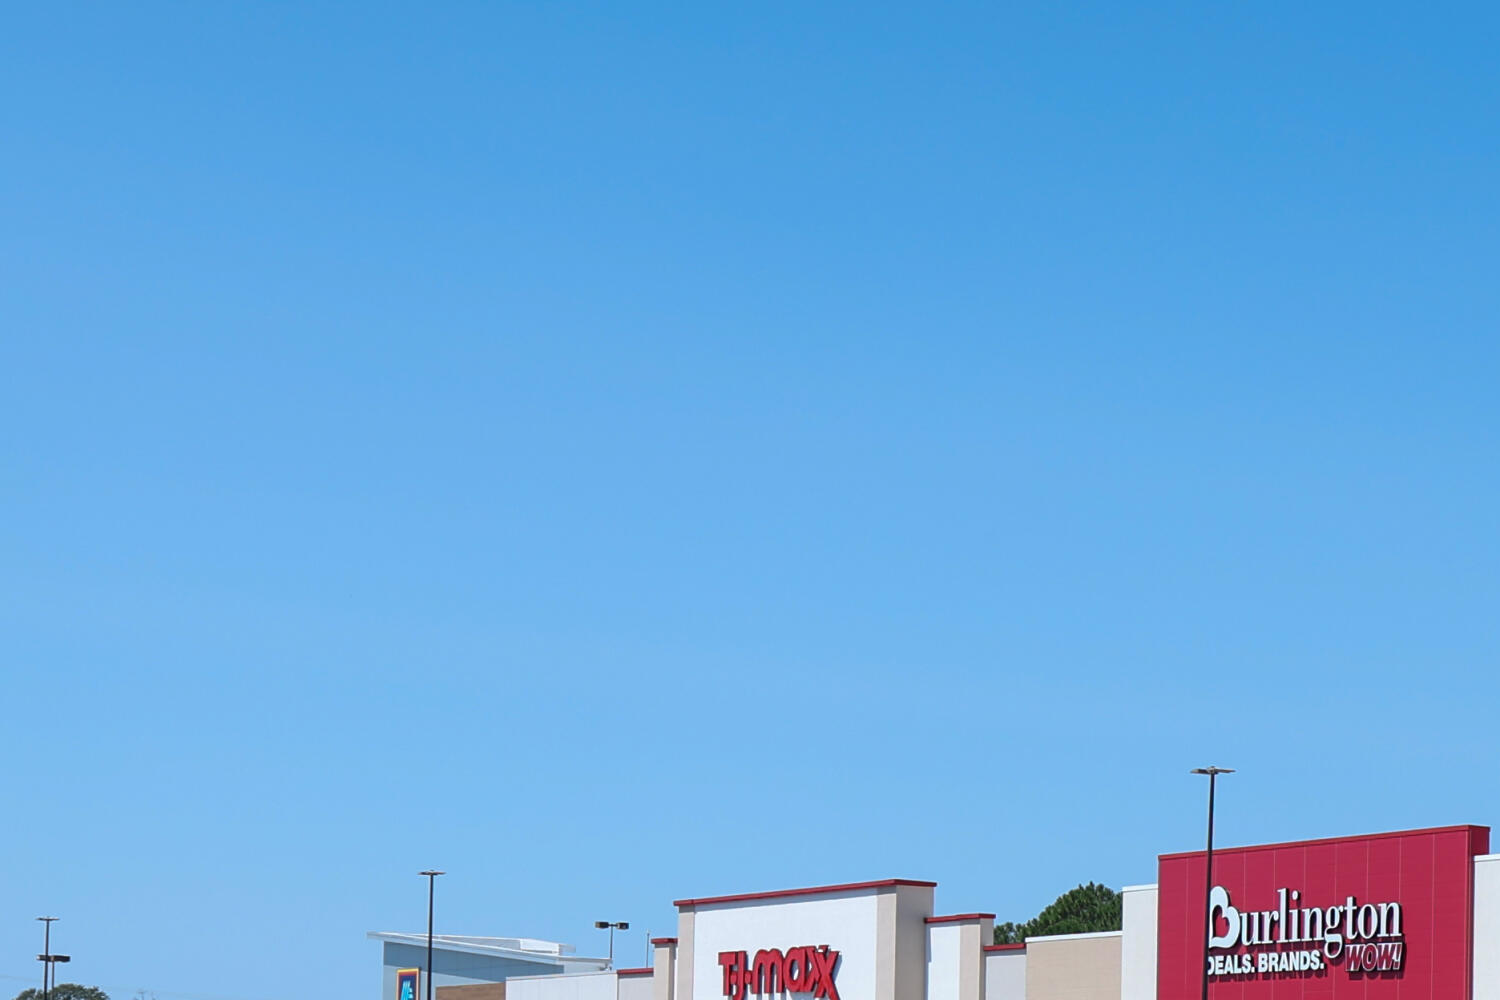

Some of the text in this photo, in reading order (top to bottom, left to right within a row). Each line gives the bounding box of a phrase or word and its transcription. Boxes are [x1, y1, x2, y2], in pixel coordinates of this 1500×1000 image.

[1208, 885, 1402, 959] Burlington
[1257, 950, 1325, 972] BRANDS.
[1345, 942, 1402, 972] WOW!
